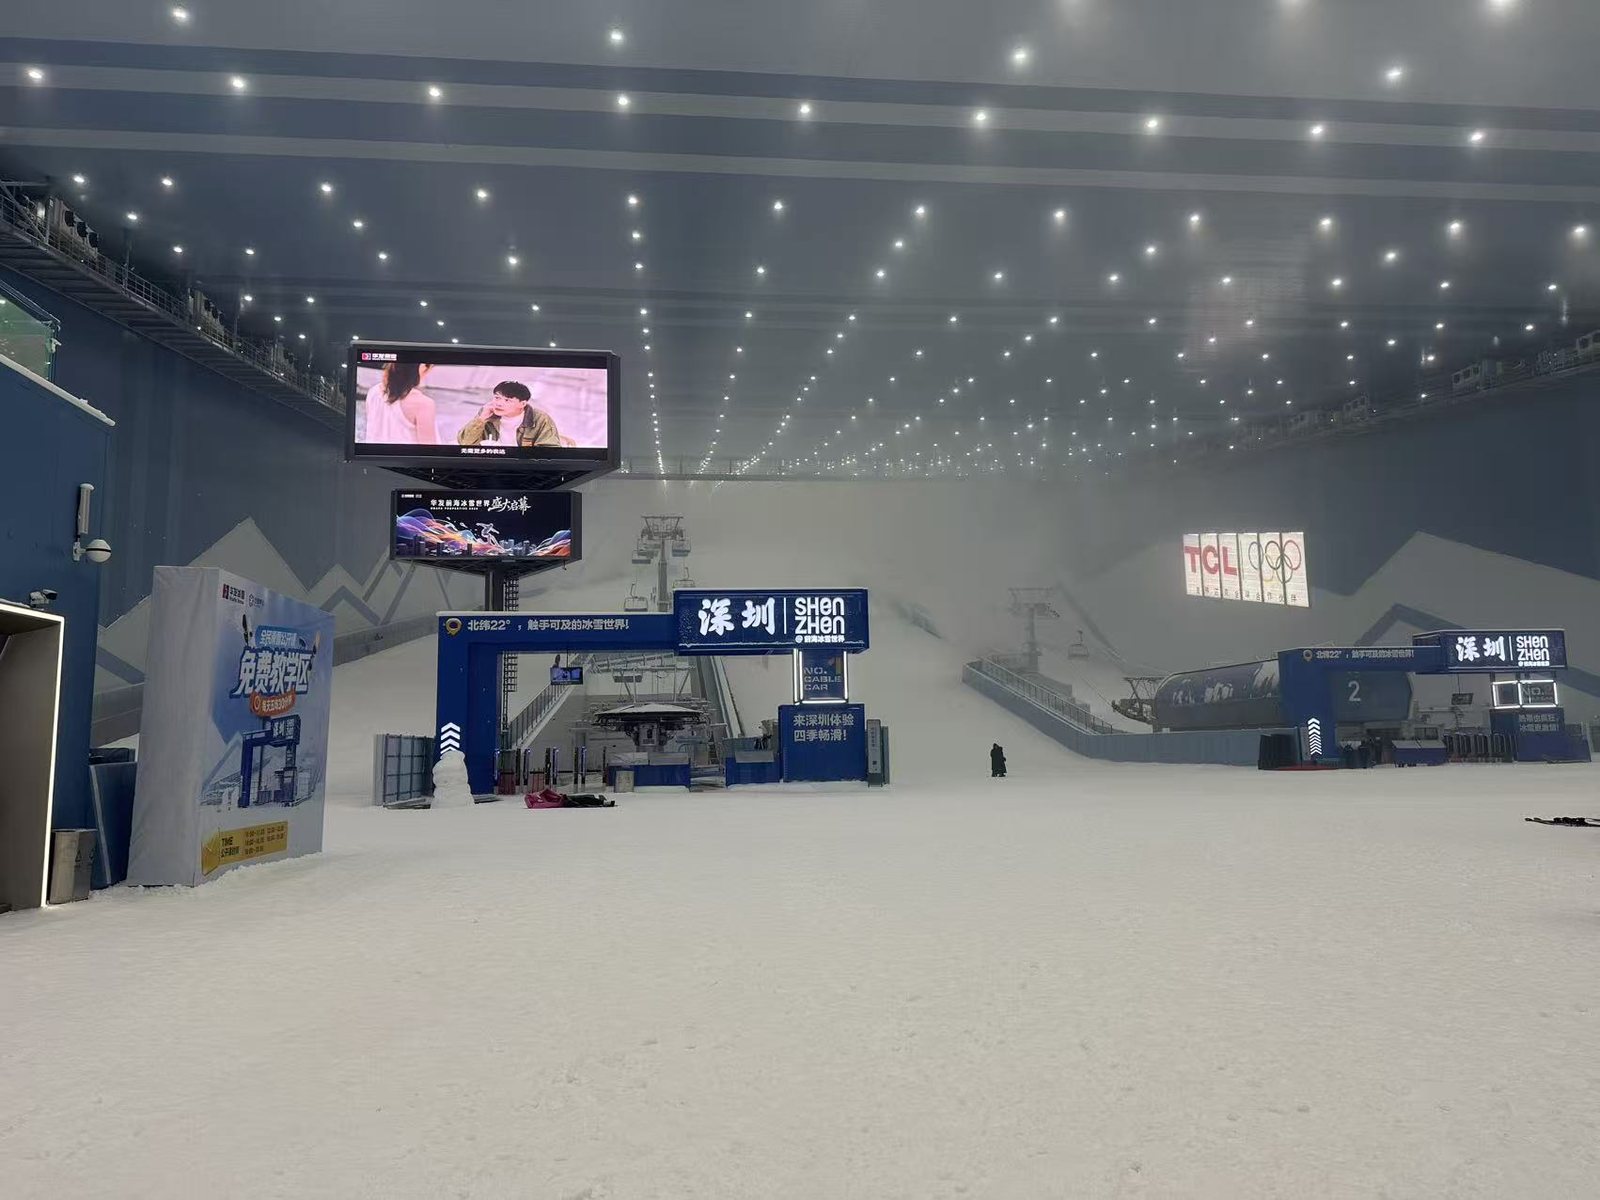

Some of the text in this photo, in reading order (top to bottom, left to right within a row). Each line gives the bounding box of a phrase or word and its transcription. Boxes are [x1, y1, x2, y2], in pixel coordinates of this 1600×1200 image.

[430, 496, 531, 515] 华发前海冰雪世界 盛大启幕
[1184, 545, 1238, 576] TCL
[698, 597, 776, 636] 深圳
[1456, 636, 1505, 661] 深圳
[232, 650, 313, 694] 免费教学区
[803, 675, 843, 683] CABLE
[1348, 680, 1361, 701] 2
[793, 714, 855, 726] 来深圳体验
[794, 729, 847, 742] 四季畅滑!
